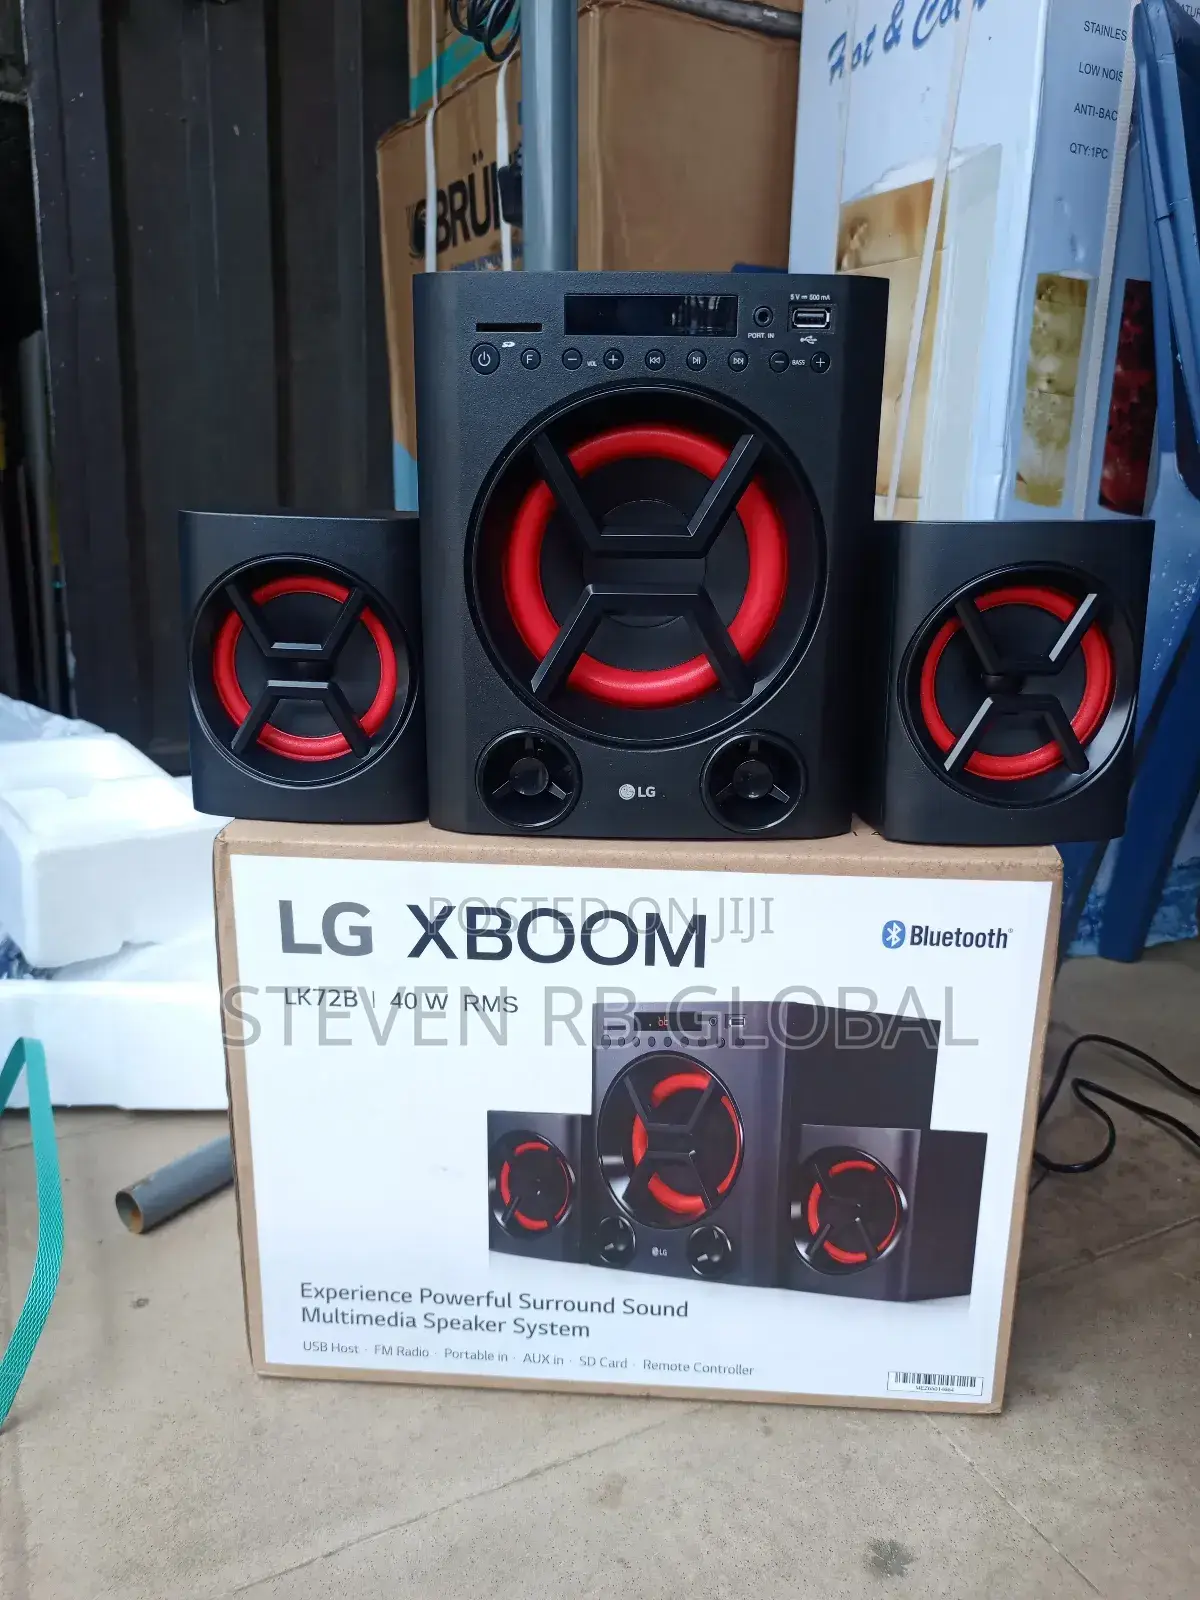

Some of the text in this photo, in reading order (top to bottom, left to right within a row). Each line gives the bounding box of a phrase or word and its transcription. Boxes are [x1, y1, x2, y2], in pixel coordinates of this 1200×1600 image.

[883, 0, 905, 54] &
[1079, 62, 1101, 77] LOW
[1073, 102, 1119, 122] ANTI-BAC
[1069, 142, 1109, 160] QTY:1PC
[526, 354, 534, 364] F
[637, 786, 656, 798] LG
[279, 899, 707, 968] LG XBOOM
[284, 987, 519, 1013] LK72B 40 W RMS
[301, 1282, 689, 1318] Experience Powerful Surround Sound
[302, 1306, 591, 1339] Multimedia Speaker System
[303, 1341, 755, 1376] USB Host FM Radio Portable in AUX in SD Card Remote Controller
